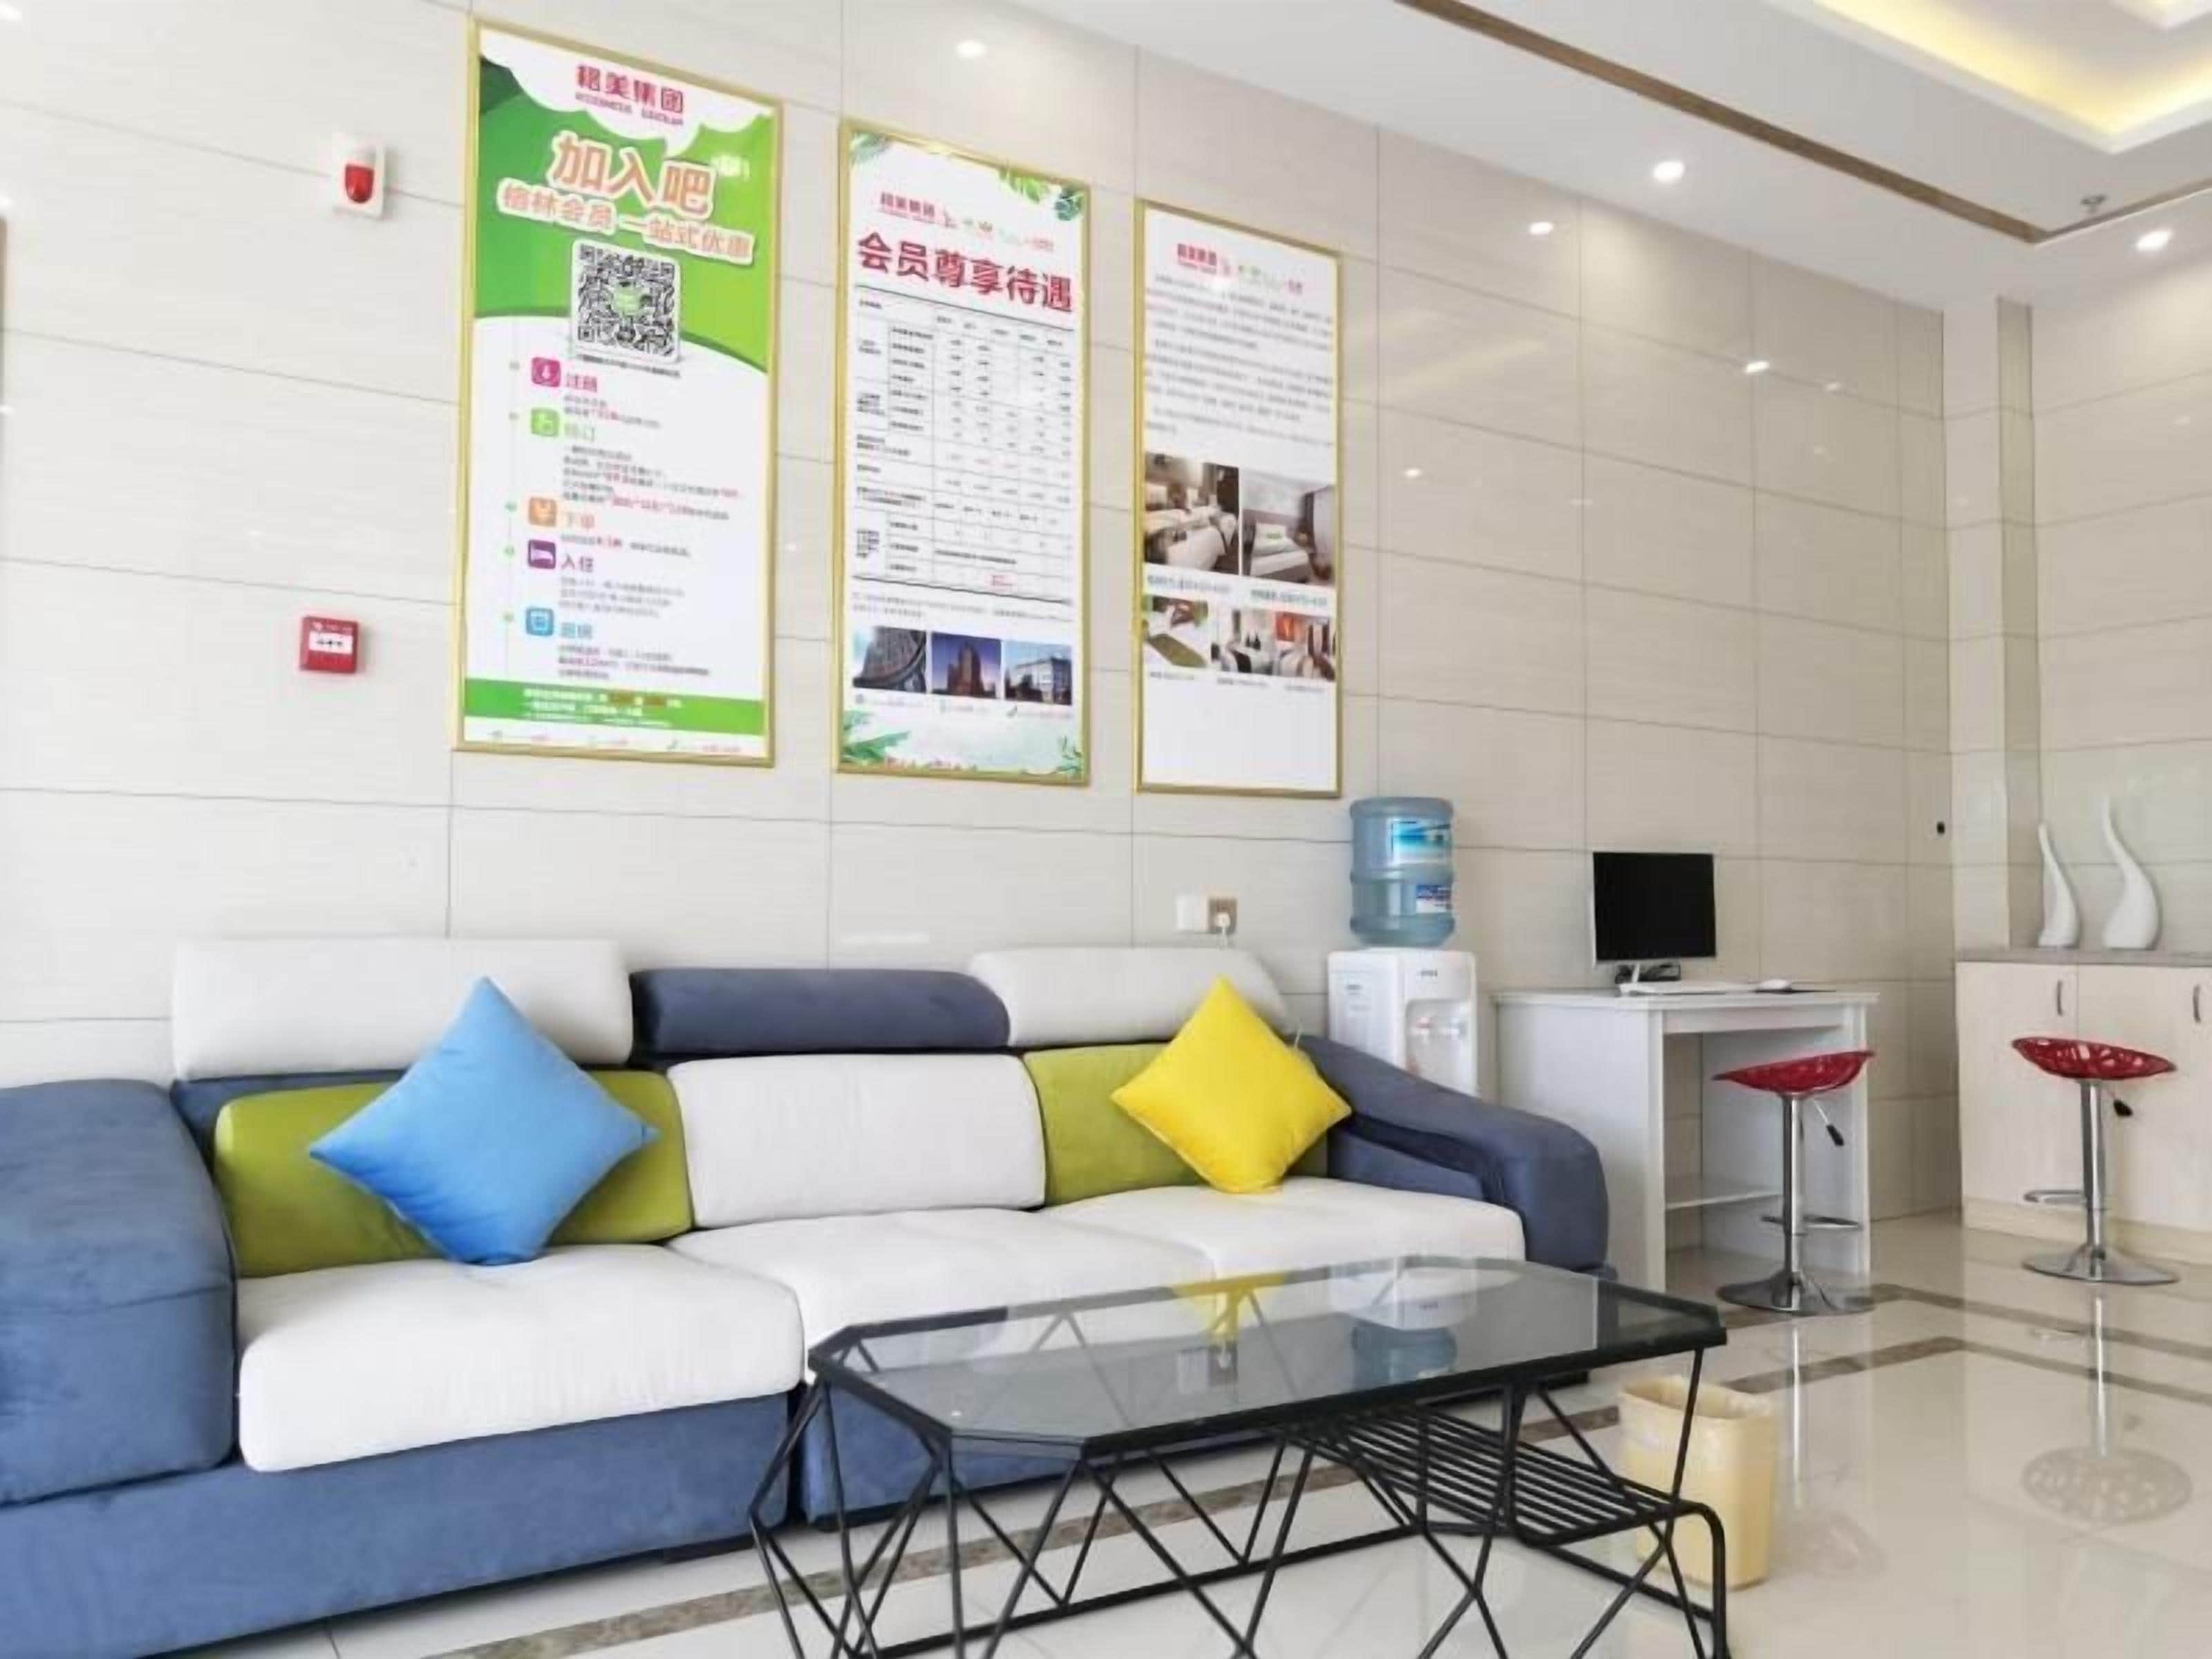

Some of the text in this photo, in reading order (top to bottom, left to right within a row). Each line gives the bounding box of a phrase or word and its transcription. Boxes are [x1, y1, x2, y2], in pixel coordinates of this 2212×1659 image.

[552, 134, 712, 213] 加入吧
[858, 232, 1074, 312] 会员尊享待遇
[560, 552, 595, 574] 入住
